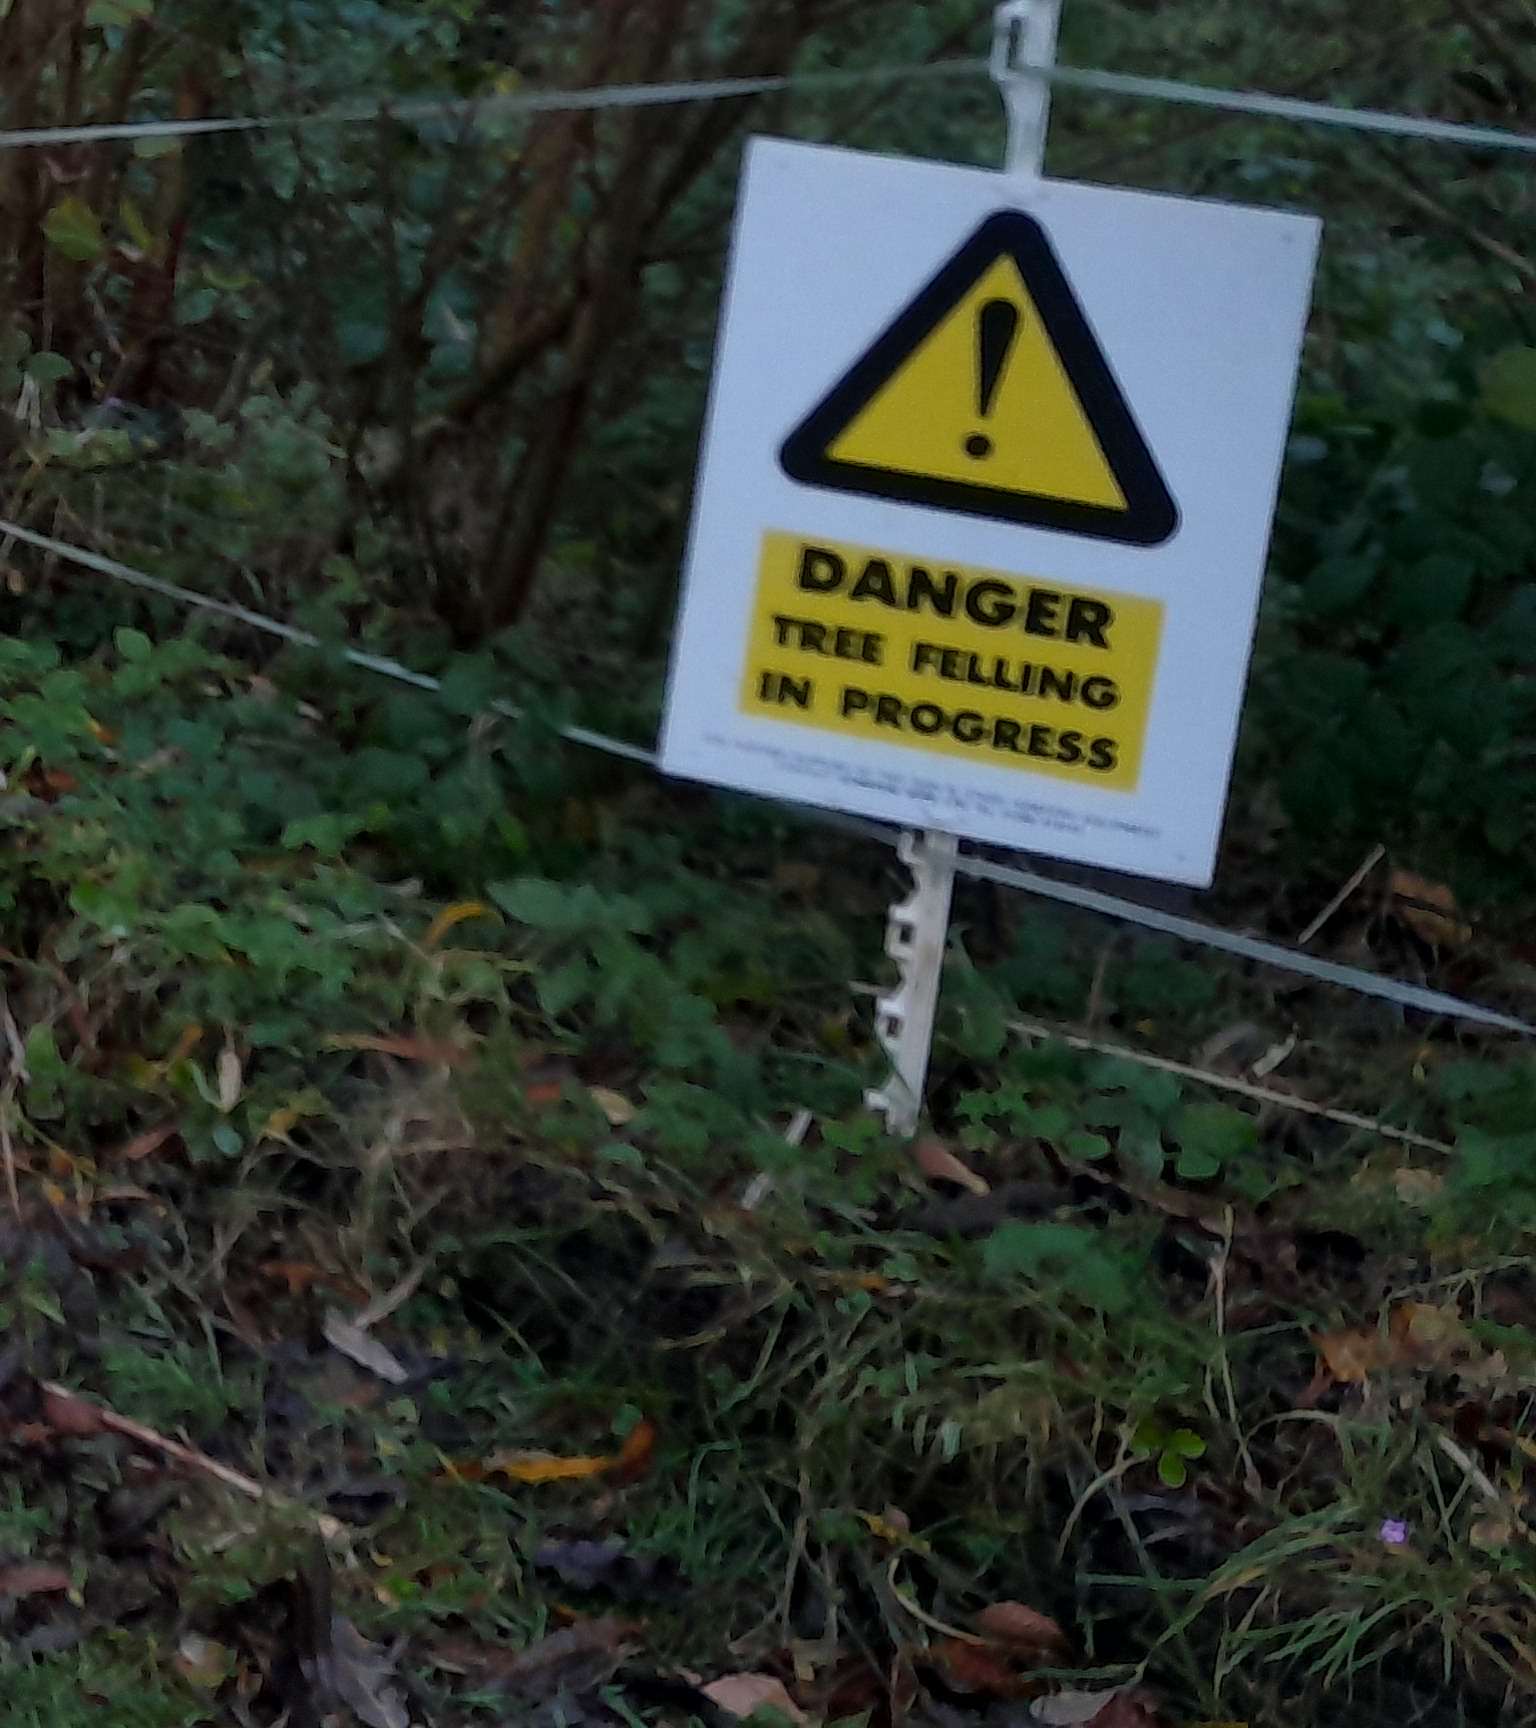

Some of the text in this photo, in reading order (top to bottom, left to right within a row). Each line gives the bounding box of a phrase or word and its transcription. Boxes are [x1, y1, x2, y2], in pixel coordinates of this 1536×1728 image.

[797, 545, 1113, 649] DANGER
[773, 615, 1120, 710] TREE FELLING
[758, 672, 1119, 772] IN PROGRESS
